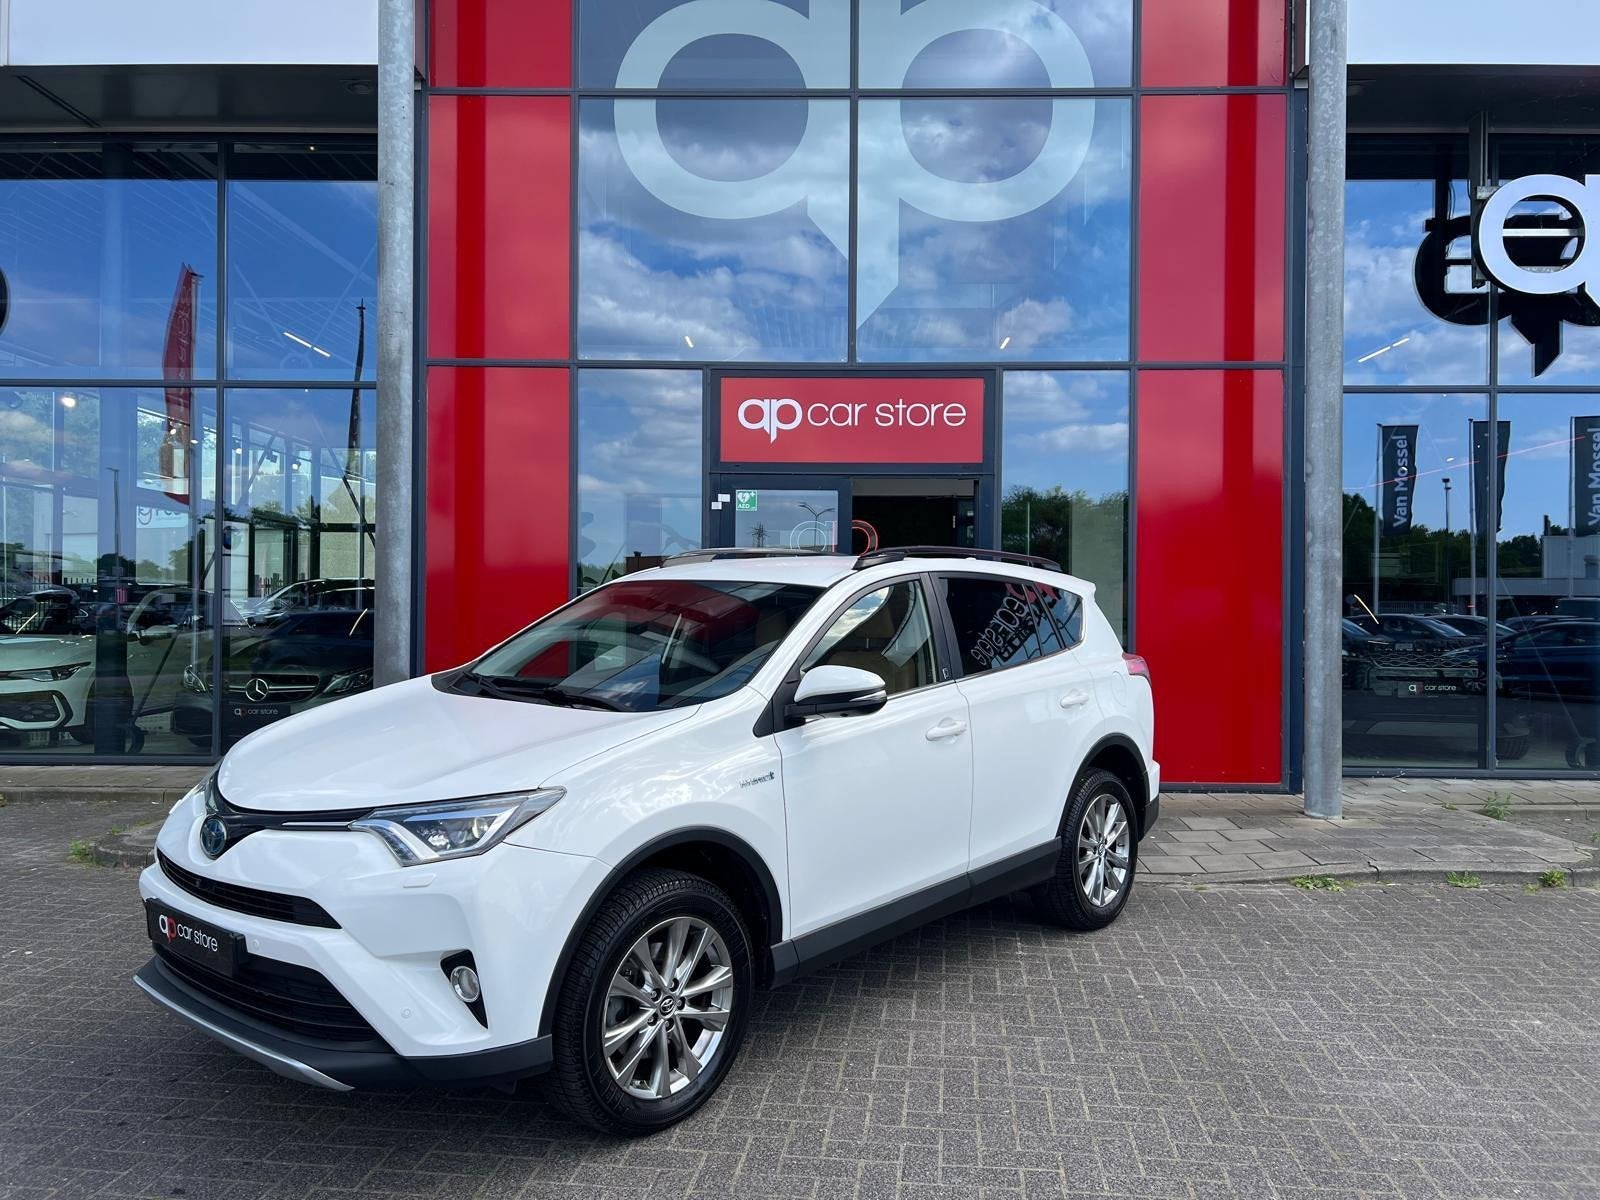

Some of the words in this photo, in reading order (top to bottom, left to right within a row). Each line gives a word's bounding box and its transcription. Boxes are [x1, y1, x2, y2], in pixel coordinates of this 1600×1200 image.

[807, 403, 868, 427] car
[875, 398, 967, 427] store
[1391, 435, 1409, 491] Mossel
[1586, 428, 1600, 489] Mossel
[1393, 496, 1408, 528] Van
[1587, 493, 1600, 526] Van
[177, 924, 192, 941] car
[193, 930, 218, 952] store
